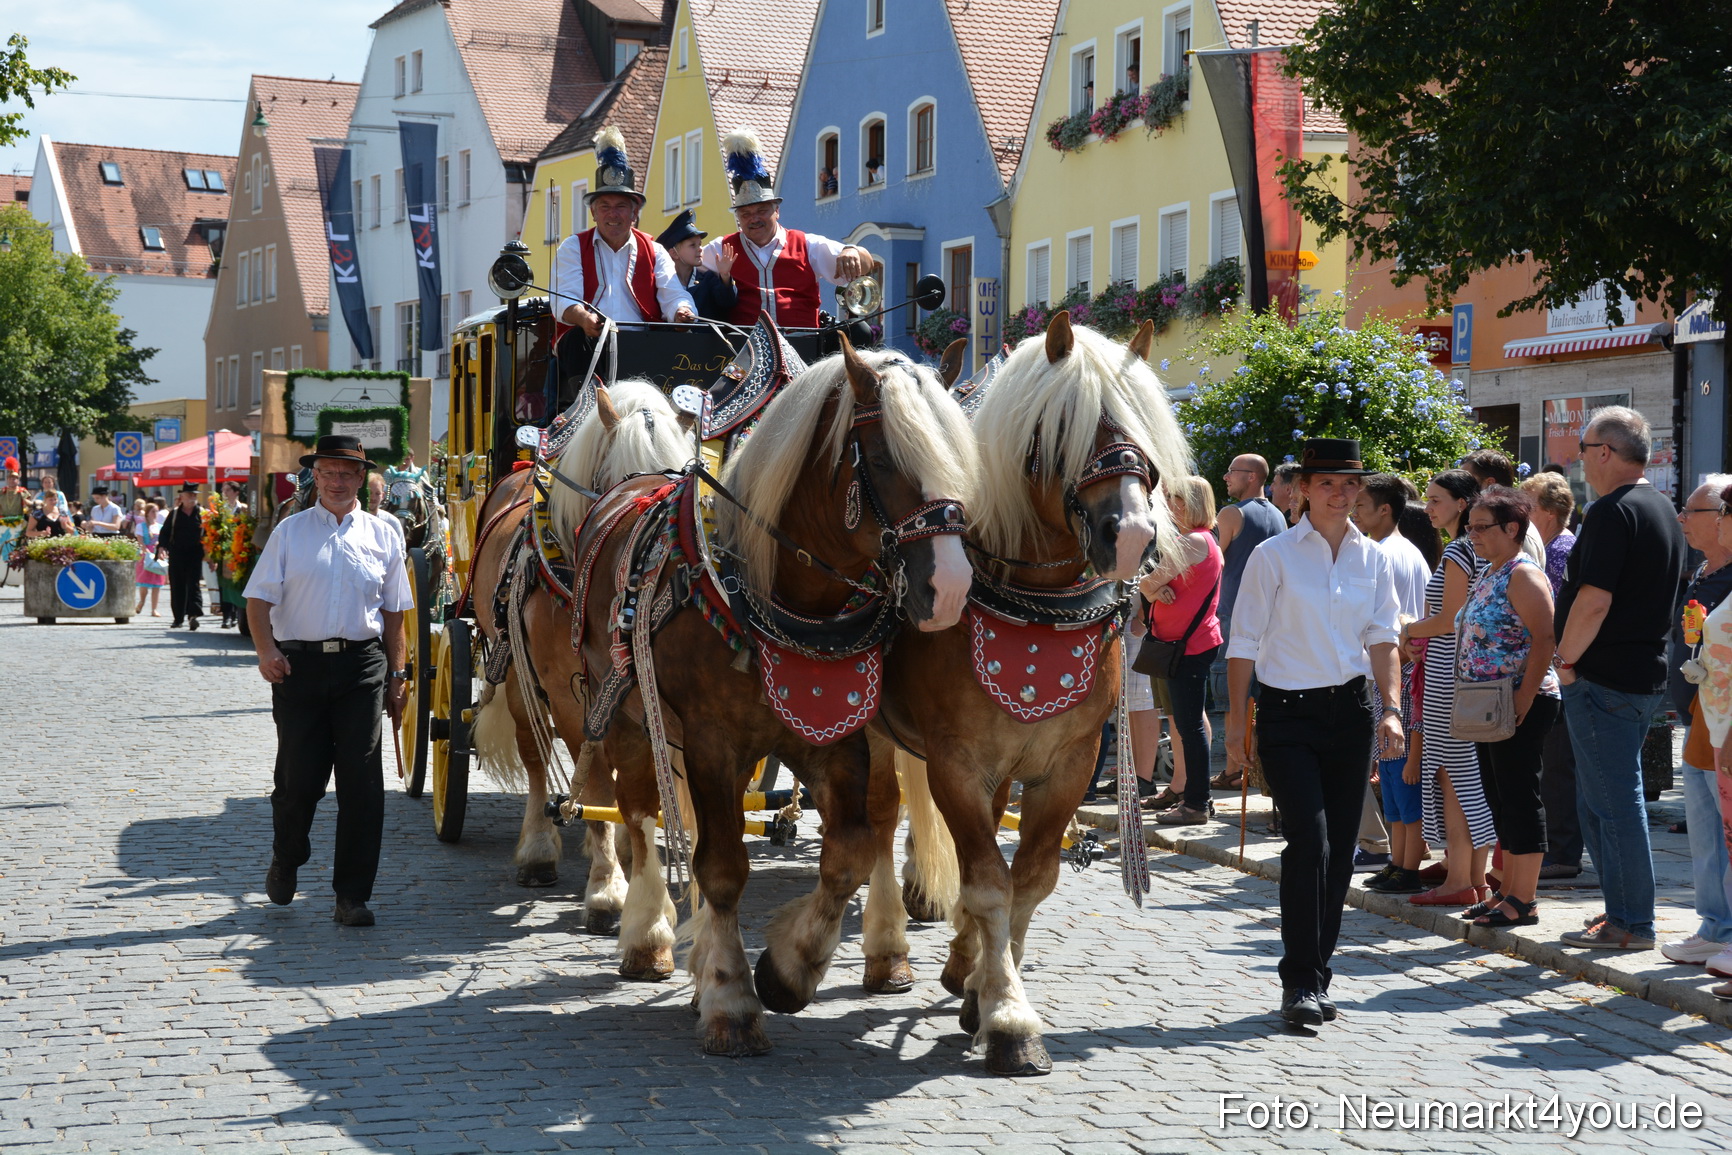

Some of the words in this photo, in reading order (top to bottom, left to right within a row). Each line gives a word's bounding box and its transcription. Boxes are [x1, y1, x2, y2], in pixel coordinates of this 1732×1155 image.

[410, 202, 435, 269] K&L
[328, 221, 358, 283] K&L
[1551, 310, 1595, 328] Italienische
[1456, 312, 1468, 355] P
[672, 353, 701, 371] Das
[1700, 379, 1710, 396] 16
[118, 459, 141, 469] TAXI
